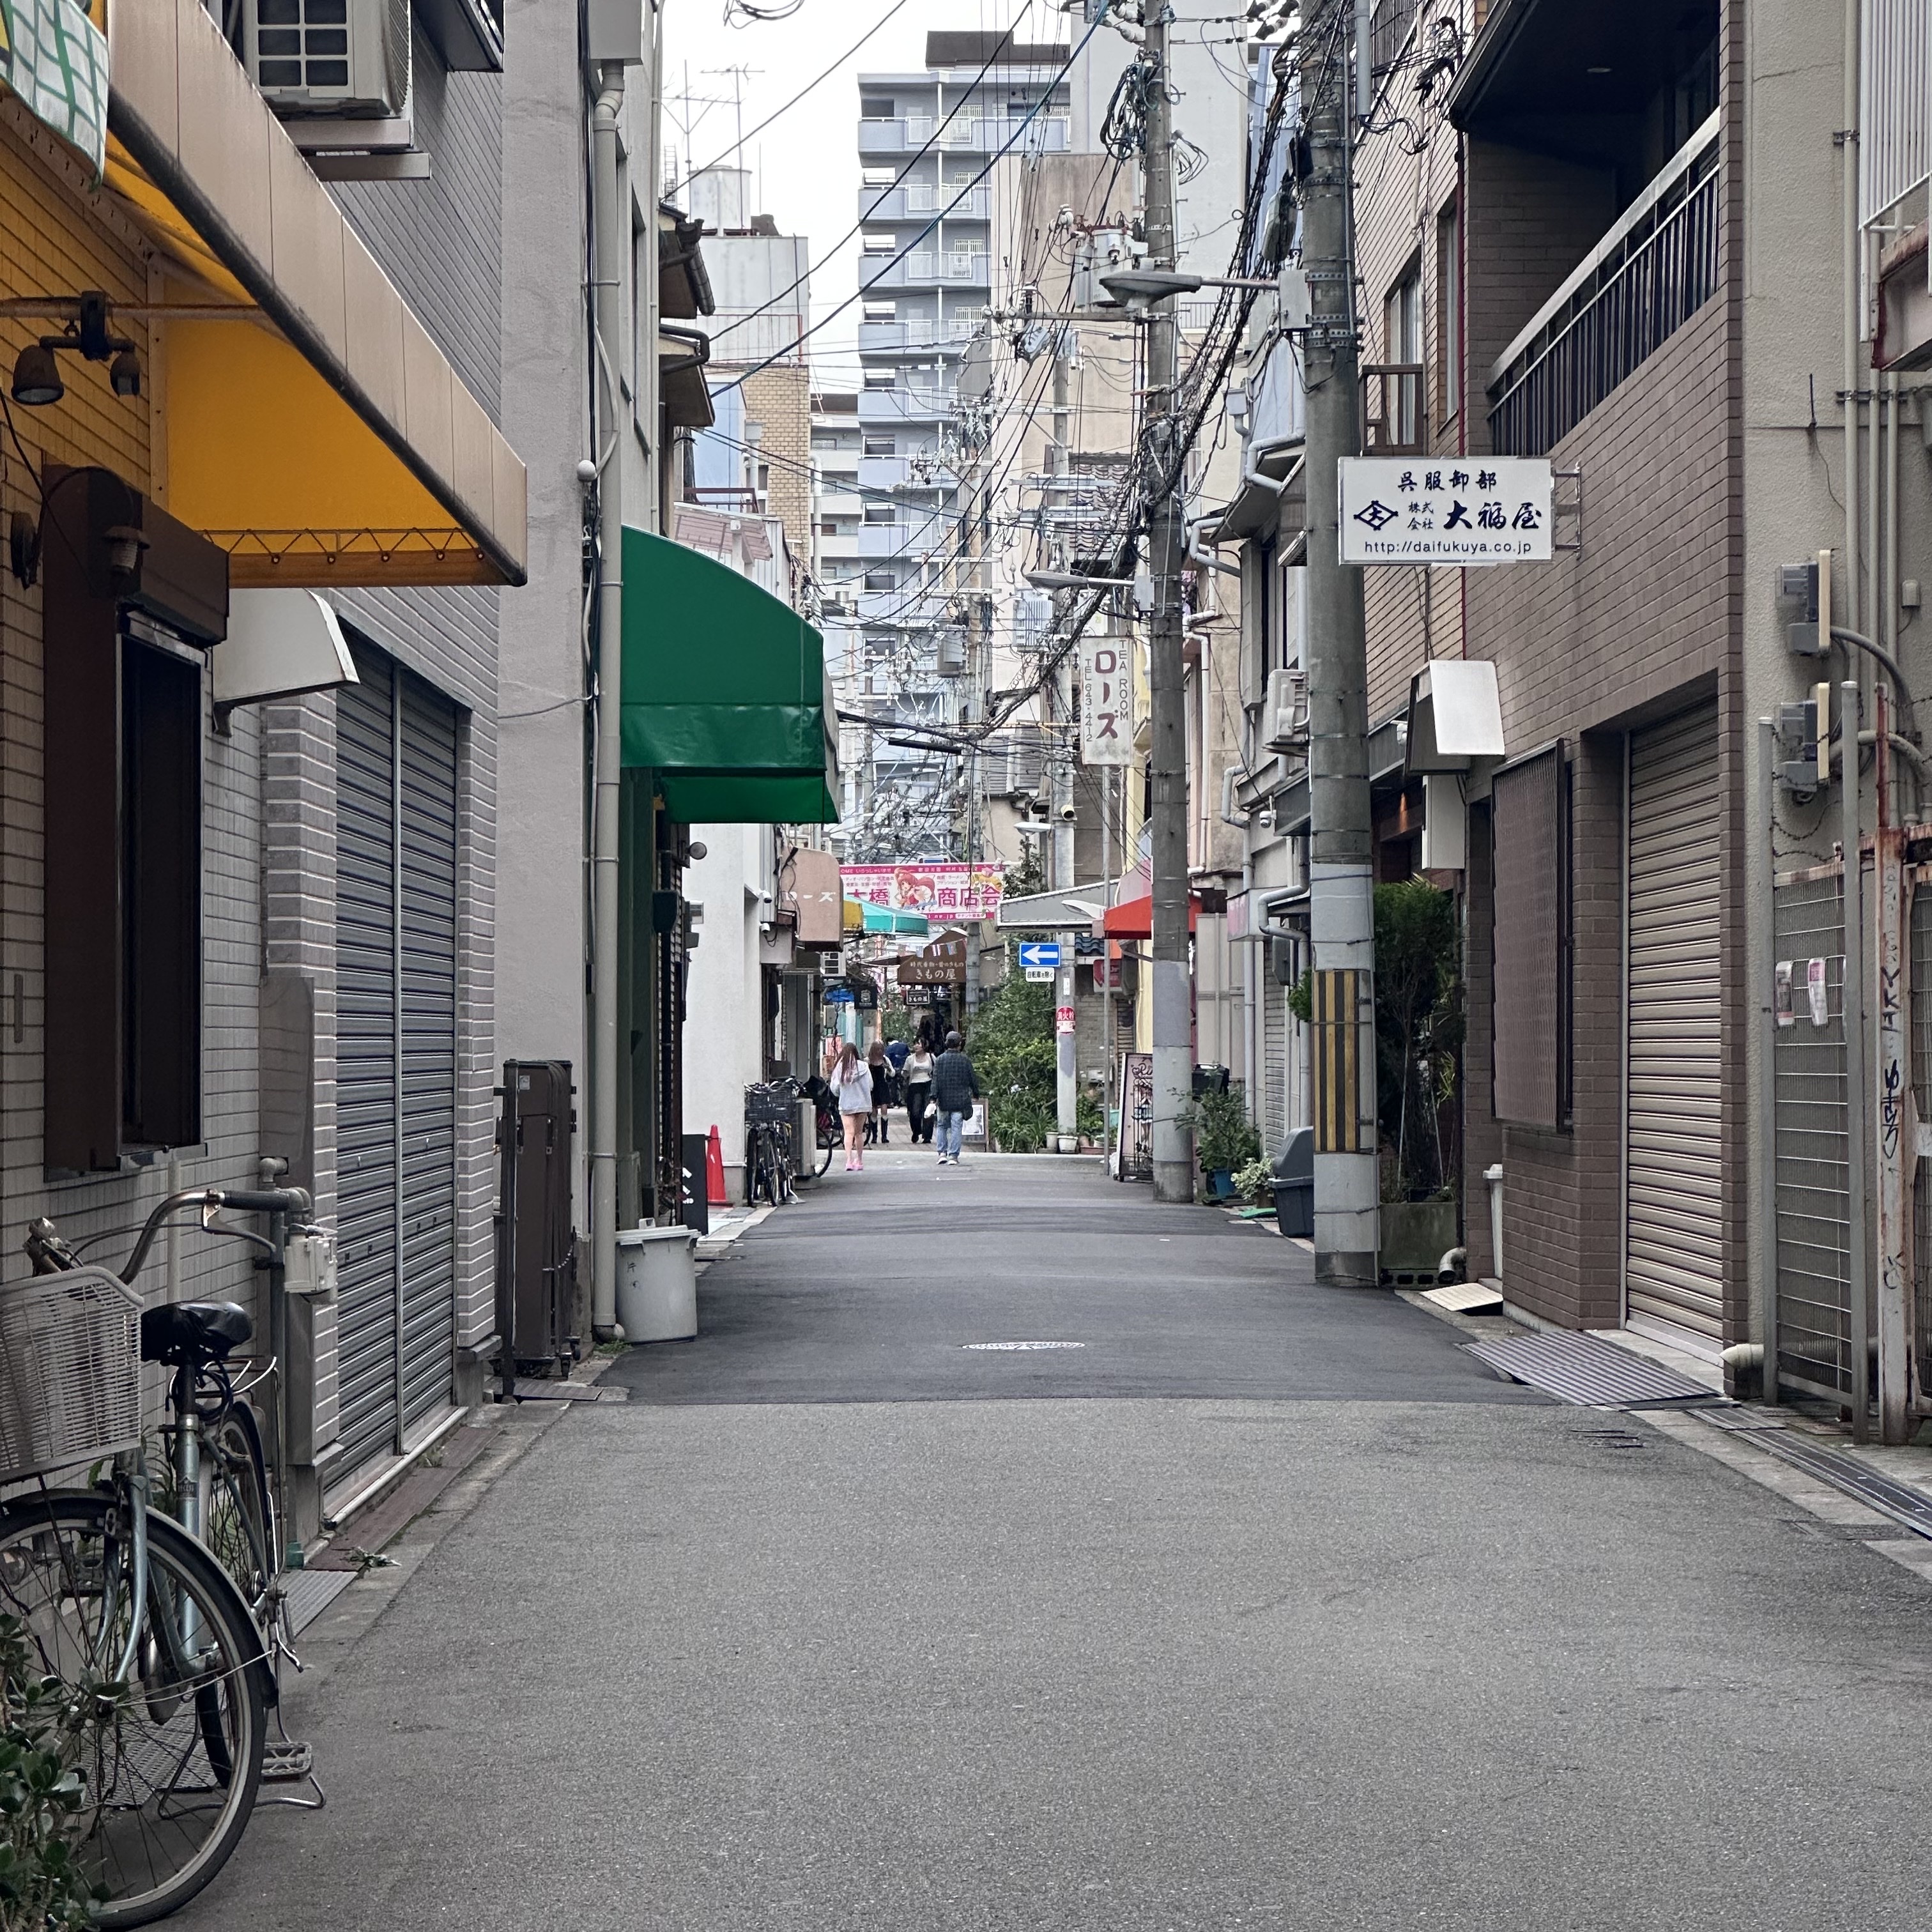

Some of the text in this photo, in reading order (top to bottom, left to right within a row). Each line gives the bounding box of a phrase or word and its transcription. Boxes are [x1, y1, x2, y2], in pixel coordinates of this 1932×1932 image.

[1398, 470, 1497, 493] 呉服卸部
[1407, 502, 1434, 514] 株式
[1444, 500, 1542, 530] 大福屋
[1407, 517, 1434, 530] 会社
[1365, 540, 1531, 555] http://daifukuya.co.jp
[1119, 640, 1128, 721] TEA ROOM
[1095, 650, 1119, 739] ローズ
[916, 969, 956, 980] きもの屋
